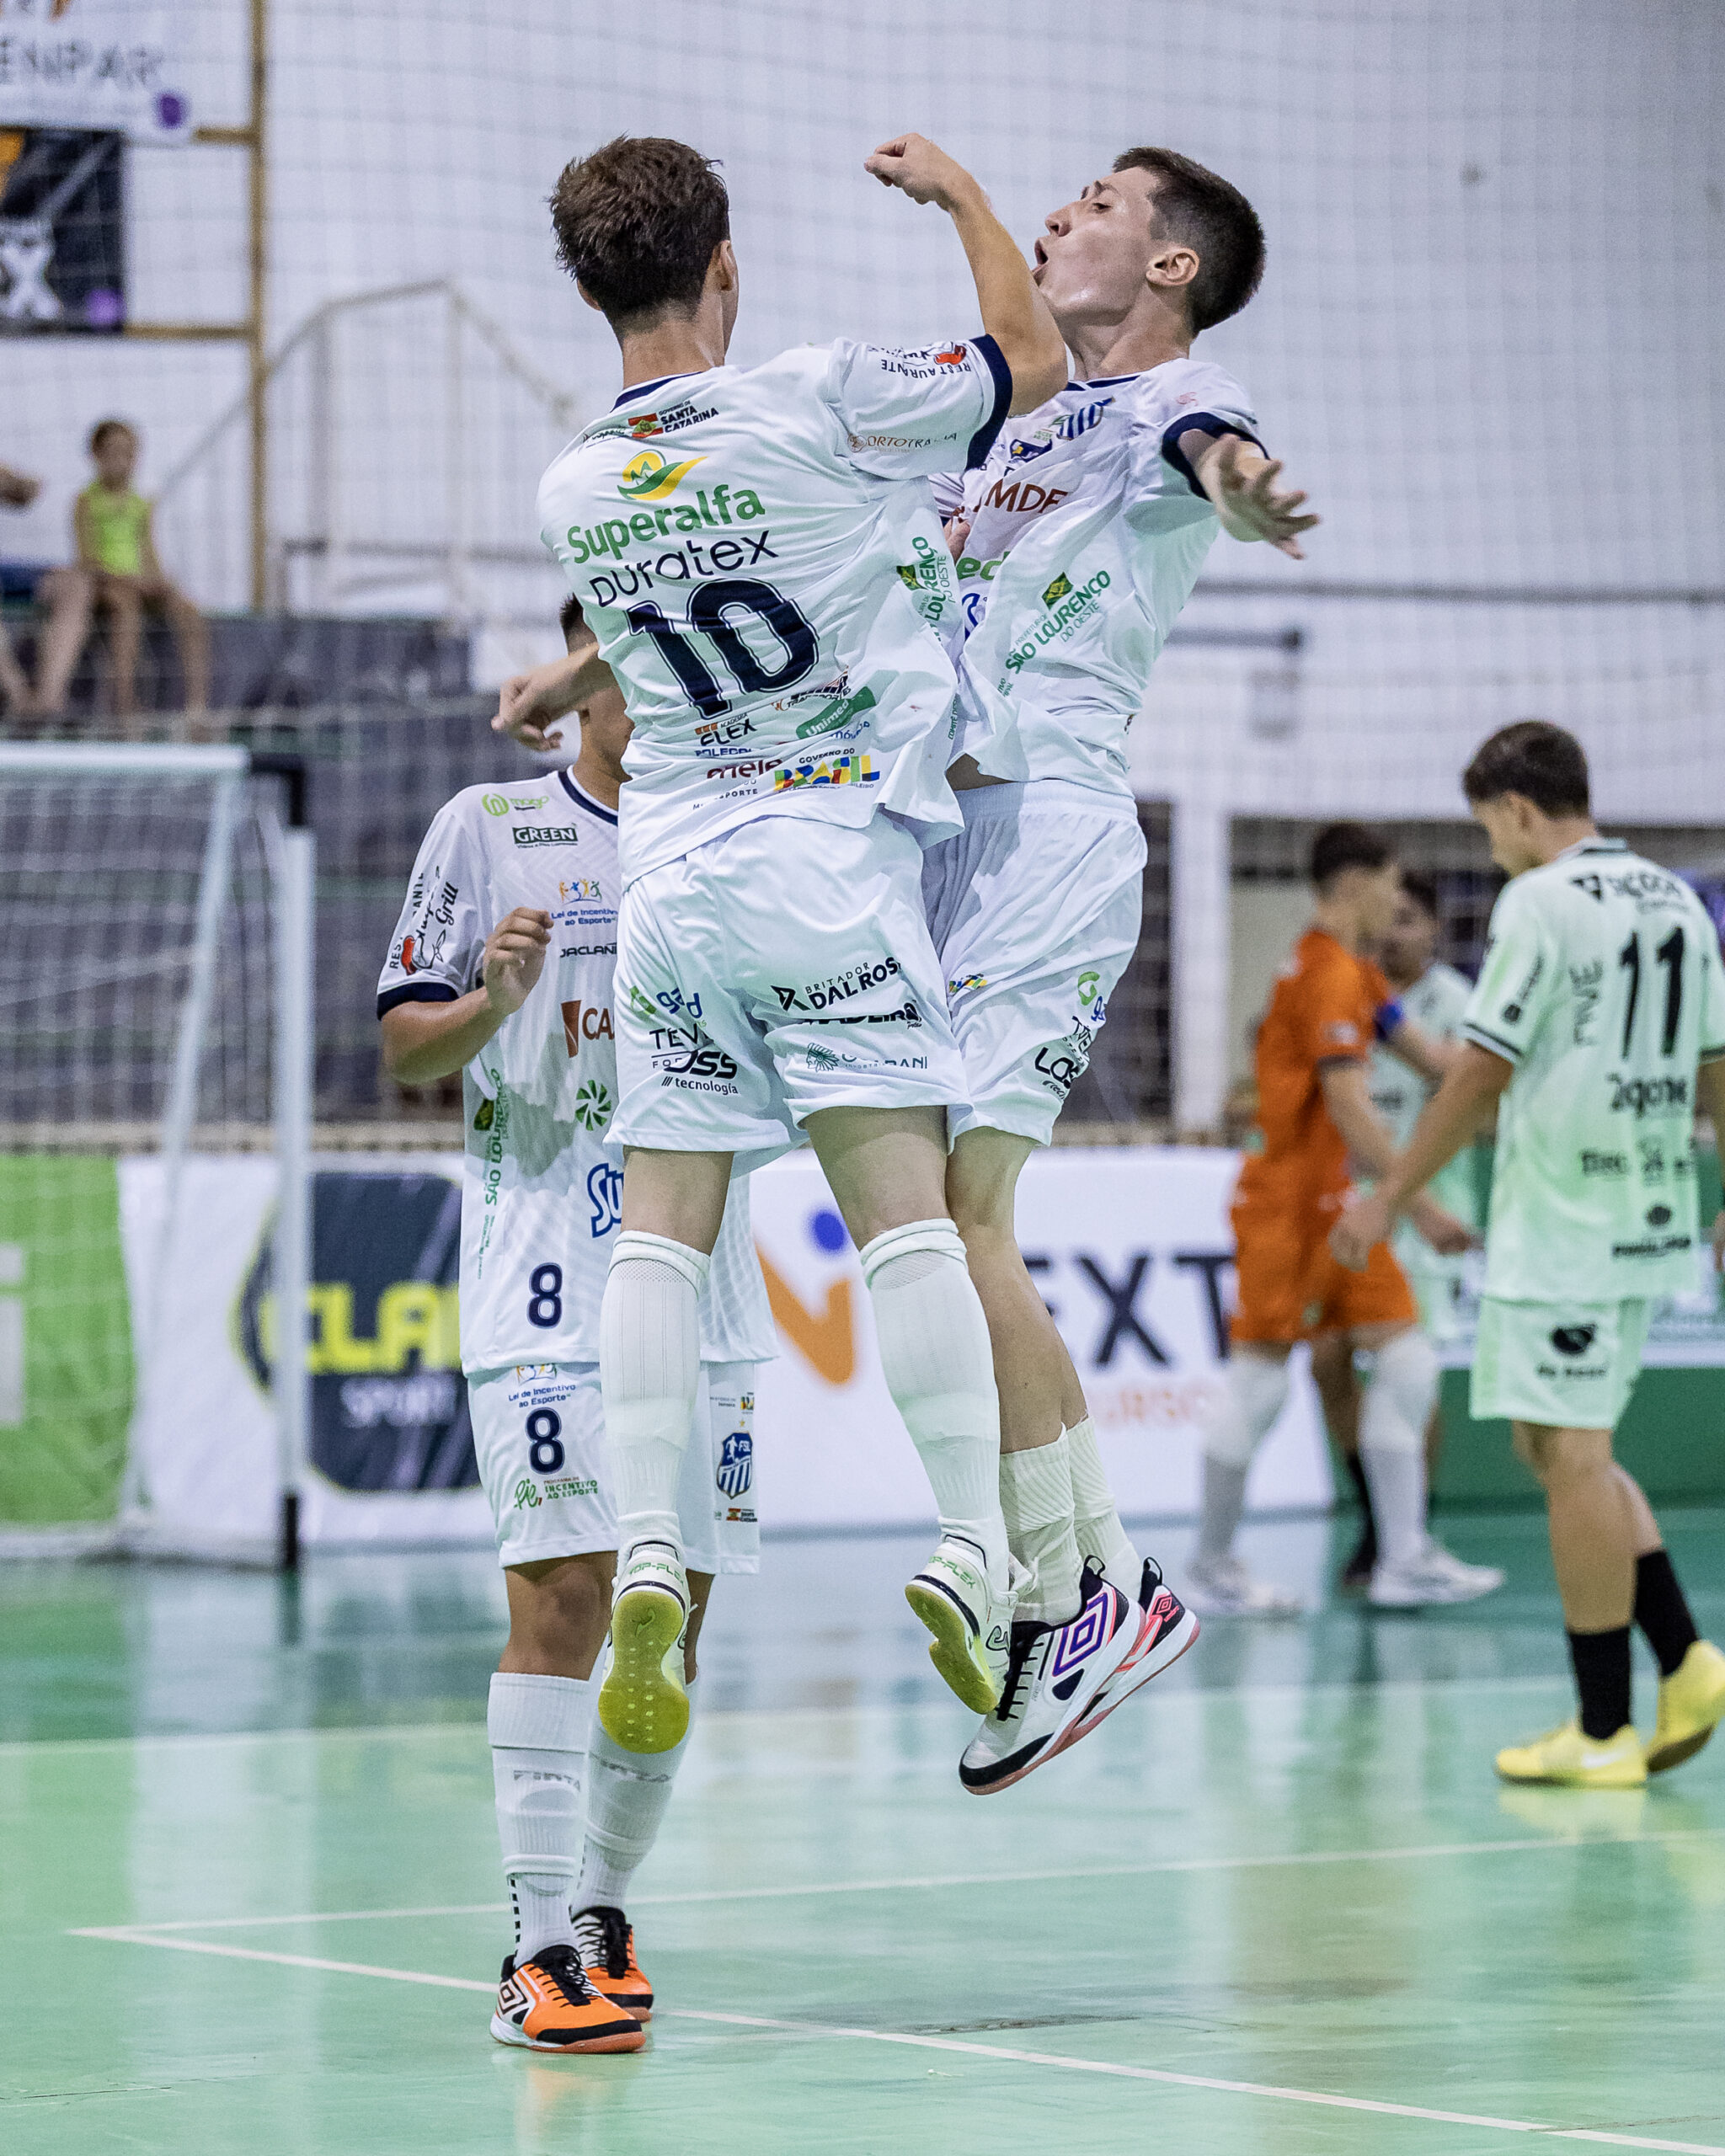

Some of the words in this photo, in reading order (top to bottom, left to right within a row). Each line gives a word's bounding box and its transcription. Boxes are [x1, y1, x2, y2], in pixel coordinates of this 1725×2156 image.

[881, 359, 971, 379] RESTAURANTE
[660, 405, 697, 424] SANTA
[665, 408, 718, 433] CATARINA
[567, 484, 766, 563] Superalfa
[590, 531, 778, 607] Duratex
[937, 556, 950, 588] OESTE
[1006, 643, 1036, 674] SÃO
[1034, 570, 1111, 645] LOURENÇO
[1060, 627, 1075, 643] DO
[1074, 600, 1100, 629] OESTE
[623, 578, 820, 720] 10
[805, 699, 850, 736] Unimed
[799, 750, 841, 764] GOVERNO
[774, 755, 880, 792] BRASIL
[515, 828, 575, 841] GREEN
[435, 882, 458, 926] Grill
[552, 911, 565, 920] Lei
[578, 916, 611, 925] Esporte
[805, 962, 870, 995] BRITADOR
[1619, 926, 1685, 1060] 11
[676, 1077, 739, 1096] tecnología
[526, 1262, 563, 1330] 8
[508, 1392, 520, 1402] Lei
[521, 1390, 531, 1398] de
[533, 1384, 576, 1396] Incentivo
[519, 1398, 529, 1408] ao
[531, 1394, 567, 1406] Esporte
[525, 1406, 565, 1476] 8
[544, 1479, 598, 1492] INCENTIVO
[563, 1487, 598, 1498] ESPORTE
